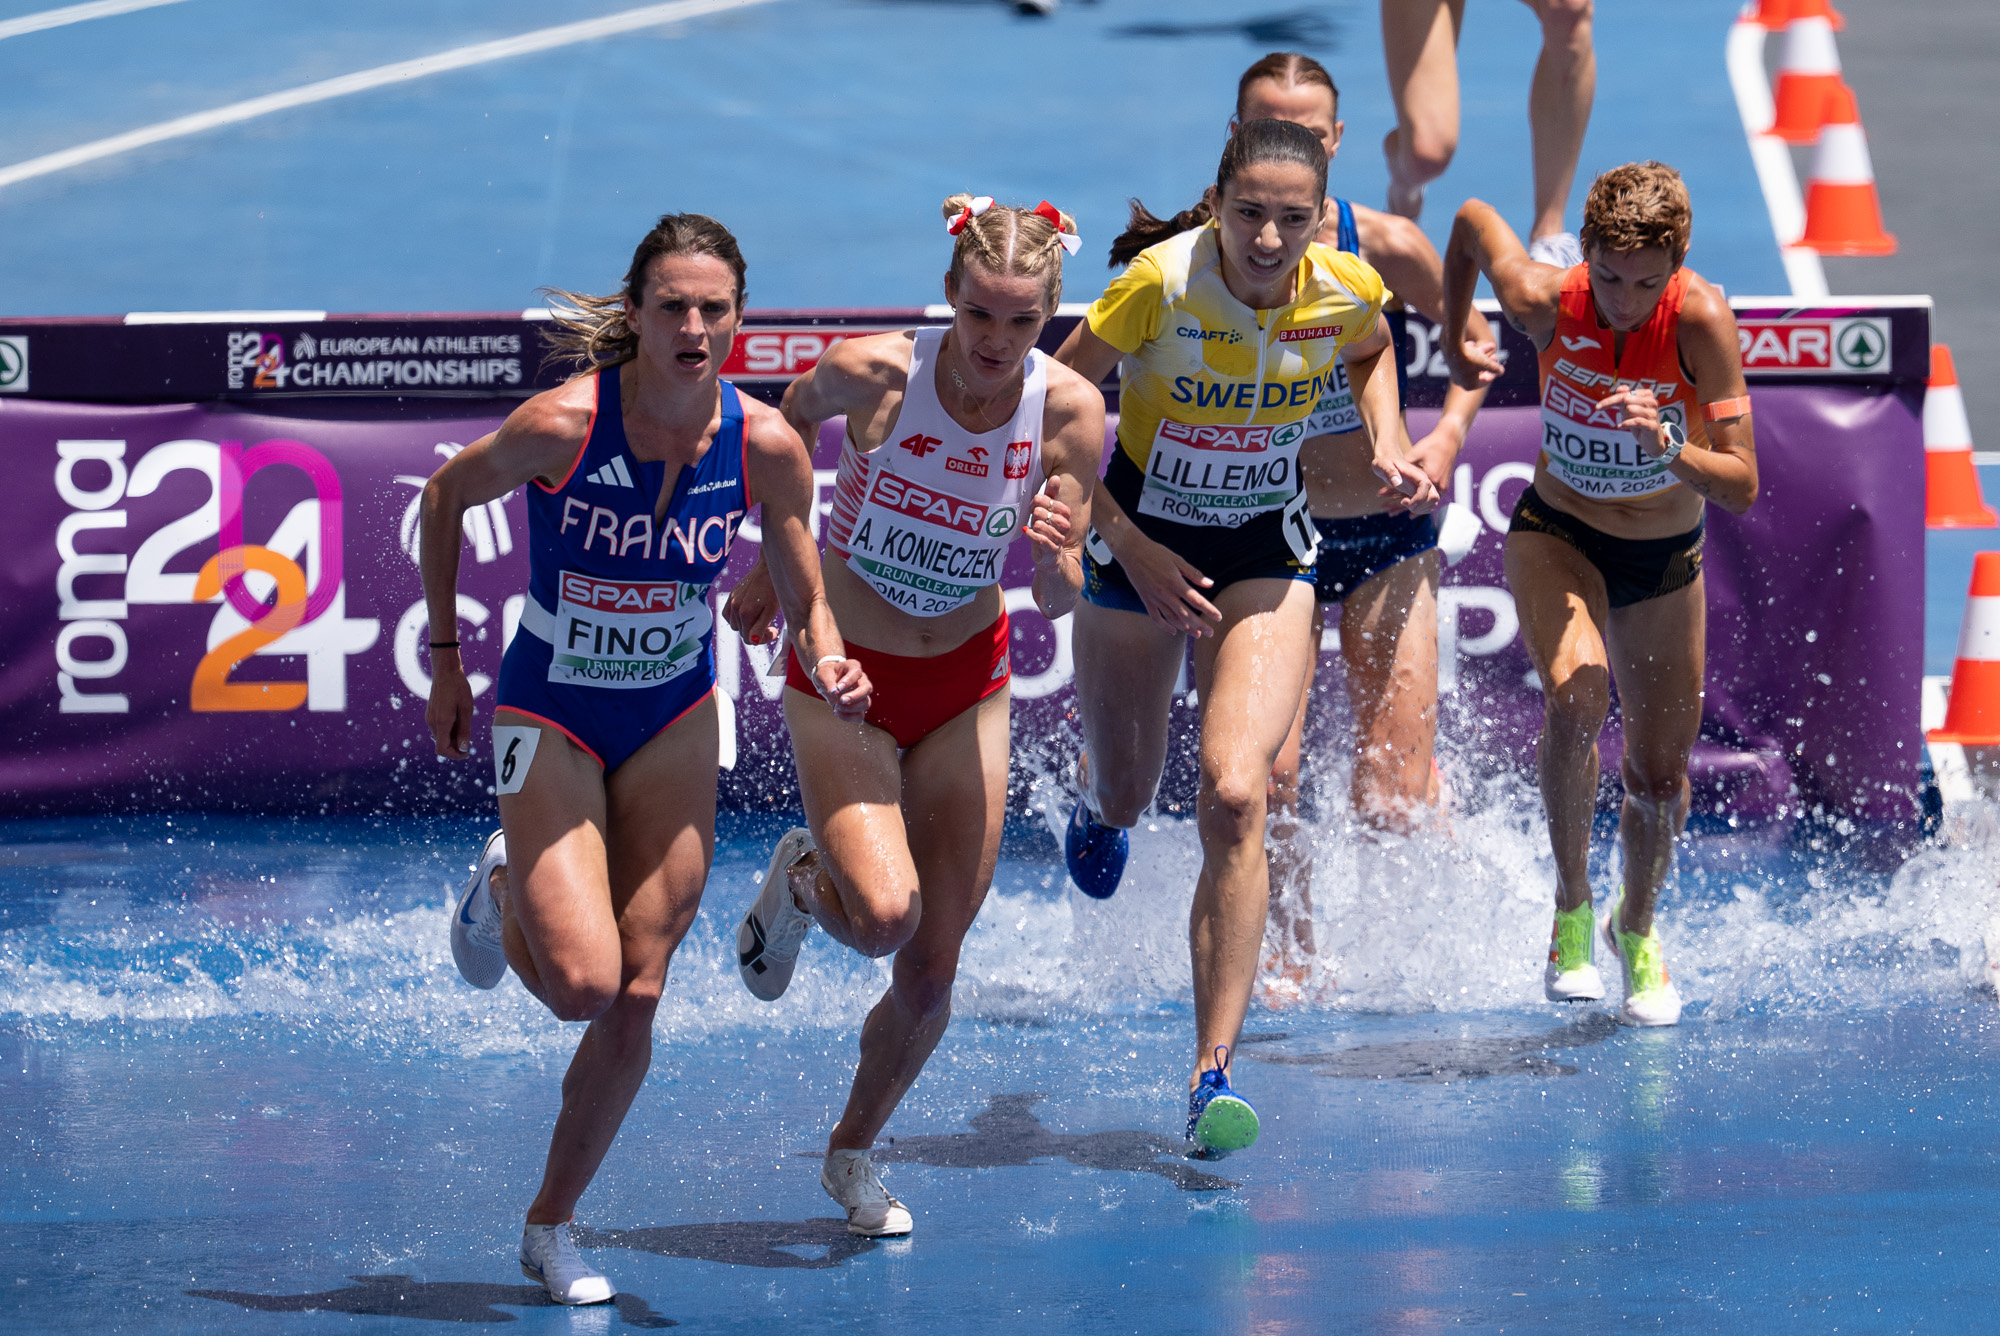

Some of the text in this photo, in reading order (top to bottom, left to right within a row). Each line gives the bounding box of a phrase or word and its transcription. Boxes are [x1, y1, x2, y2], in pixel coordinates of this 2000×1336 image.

[320, 334, 521, 356] EUROPEAN ATHLETICS
[1176, 326, 1229, 341] CRAFT
[1280, 326, 1342, 341] BAUHAUS
[292, 359, 522, 387] CHAMPIONSHIPS
[1170, 370, 1329, 409] SWEDEN
[899, 433, 943, 458] 4F
[1164, 423, 1269, 449] SPAR
[948, 460, 986, 475] ORLEN
[1150, 451, 1289, 491] LILLEMO
[1562, 469, 1667, 493] ROMA 2024
[1573, 465, 1603, 476] RUN
[874, 477, 983, 531] SPAR
[1161, 497, 1222, 525] ROMA
[1181, 494, 1212, 506] RUN
[560, 496, 743, 564] FRANCE
[852, 517, 1002, 580] A. KONIECZEK
[54, 440, 129, 714] roma
[874, 563, 880, 574] I
[882, 565, 915, 586] RUN
[565, 577, 674, 609] SPAR
[872, 579, 918, 609] OMA
[567, 616, 696, 656] FINOT
[594, 661, 625, 672] RUN
[501, 736, 522, 785] 6
